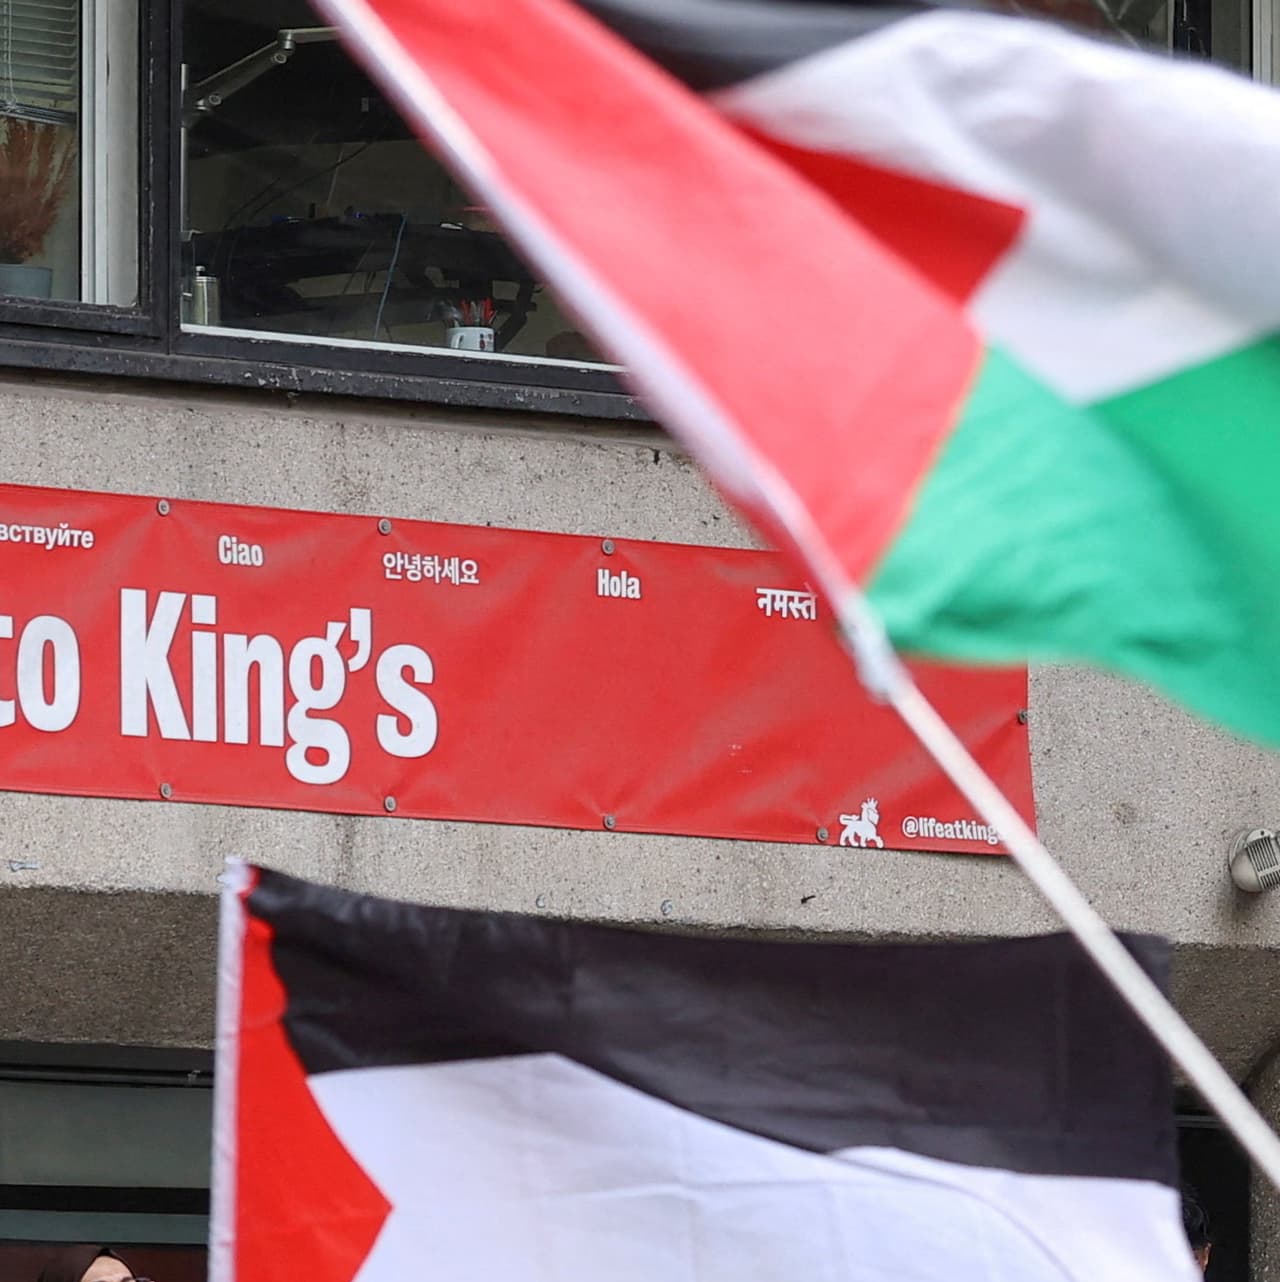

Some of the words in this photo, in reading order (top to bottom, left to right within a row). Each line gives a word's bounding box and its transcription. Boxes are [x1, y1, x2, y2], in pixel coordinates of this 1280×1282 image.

[218, 534, 264, 567] Ciao
[382, 551, 480, 586] 안녕하세요
[597, 568, 641, 599] Hola
[902, 815, 1001, 845] @lifeatking
